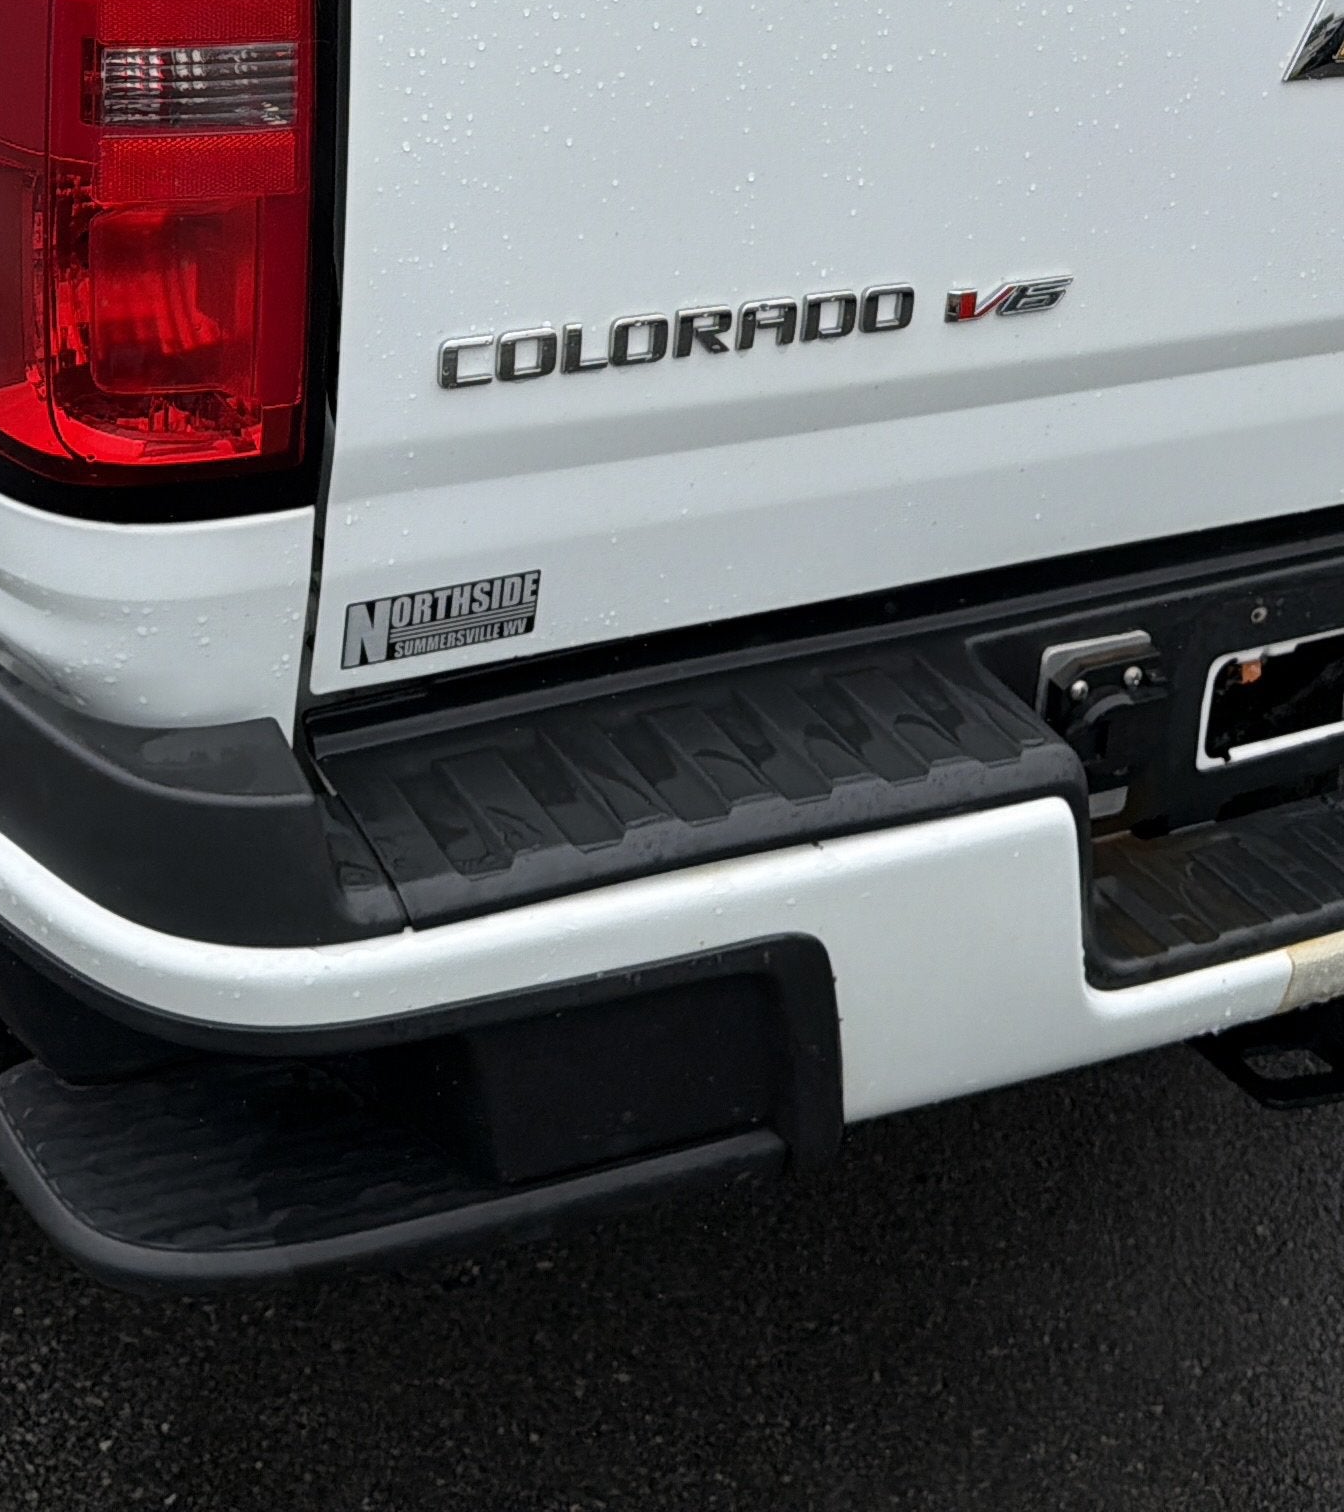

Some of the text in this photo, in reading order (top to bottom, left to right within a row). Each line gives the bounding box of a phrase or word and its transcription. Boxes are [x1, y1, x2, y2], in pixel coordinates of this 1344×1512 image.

[437, 274, 1074, 390] COLORADO V6
[344, 573, 538, 667] NORTHSIDE
[394, 617, 527, 658] SUMMERSVILLE WV
